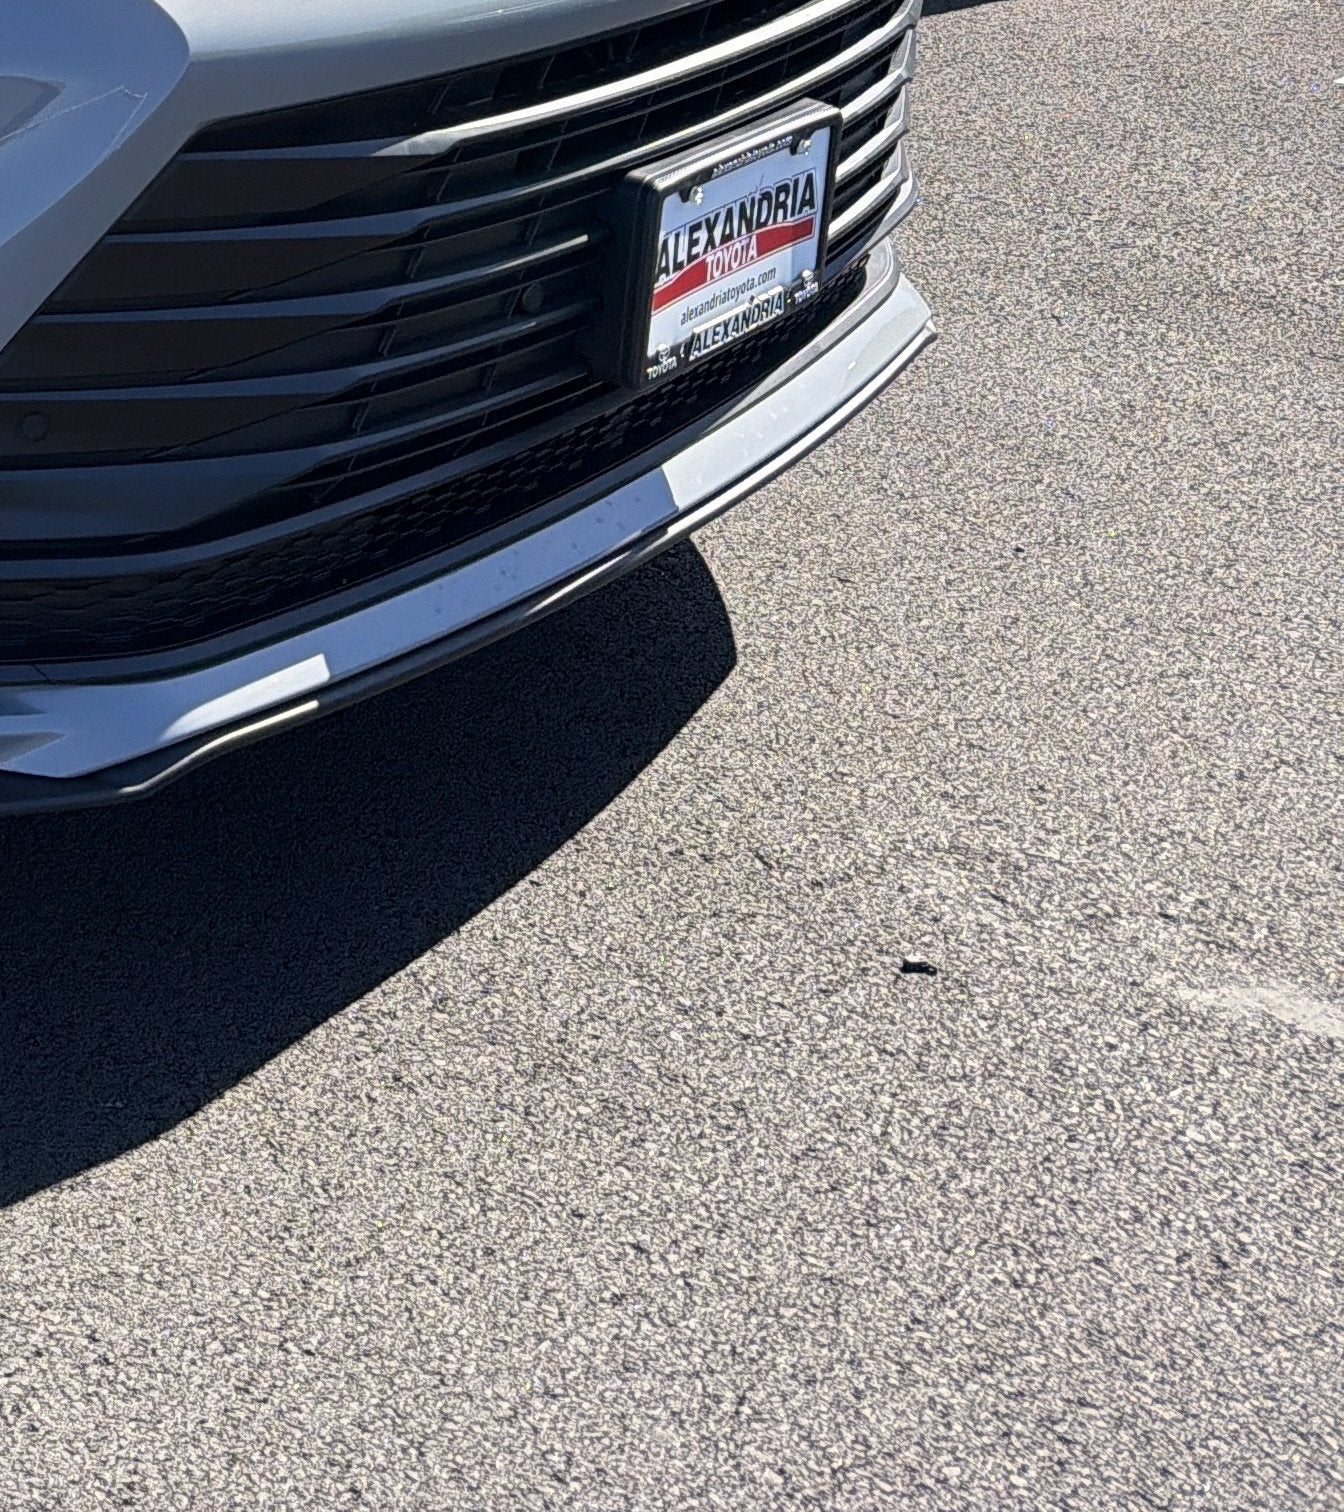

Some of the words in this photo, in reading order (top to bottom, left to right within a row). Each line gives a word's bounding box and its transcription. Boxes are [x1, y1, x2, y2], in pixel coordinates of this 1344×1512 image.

[657, 172, 816, 279] ALEXANDRIA
[706, 234, 758, 282] TOYOTA
[680, 267, 777, 326] alexandriatoyota.com
[691, 291, 785, 358] ALEXANDRIA
[646, 356, 678, 380] TOYOTA
